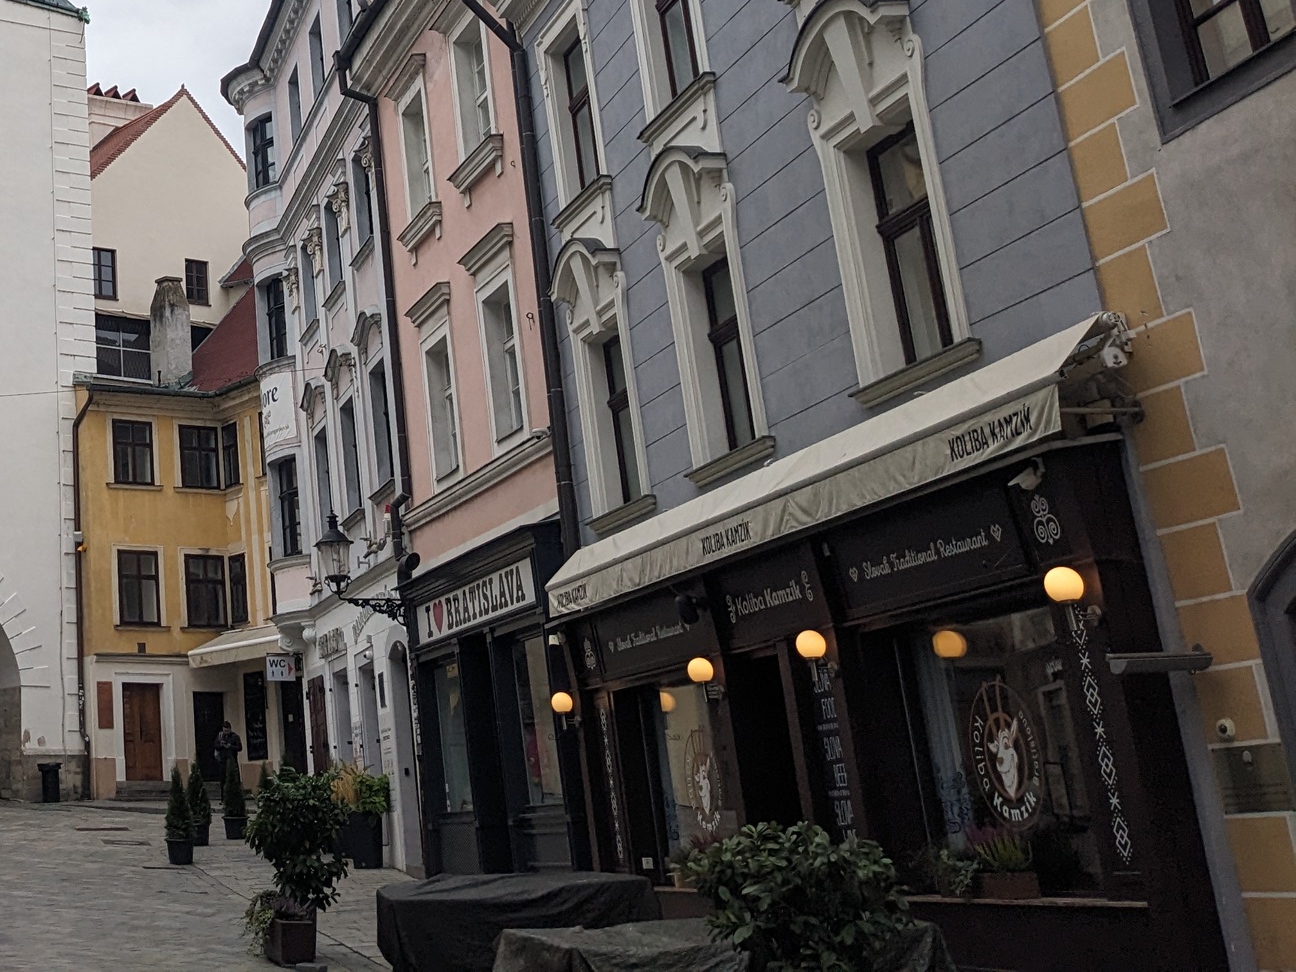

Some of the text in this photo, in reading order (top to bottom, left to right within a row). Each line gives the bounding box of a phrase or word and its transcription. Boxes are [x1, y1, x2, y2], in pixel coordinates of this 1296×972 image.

[948, 404, 1033, 462] KOLIBA KAMZÍK
[701, 532, 725, 557] KOLIBA
[862, 528, 989, 580] Slovak Traditional Restaurant
[425, 604, 433, 638] I
[445, 566, 526, 630] BRATISLAVA
[735, 593, 766, 616] Koliba
[269, 659, 286, 668] WC
[974, 715, 990, 792] Koliba
